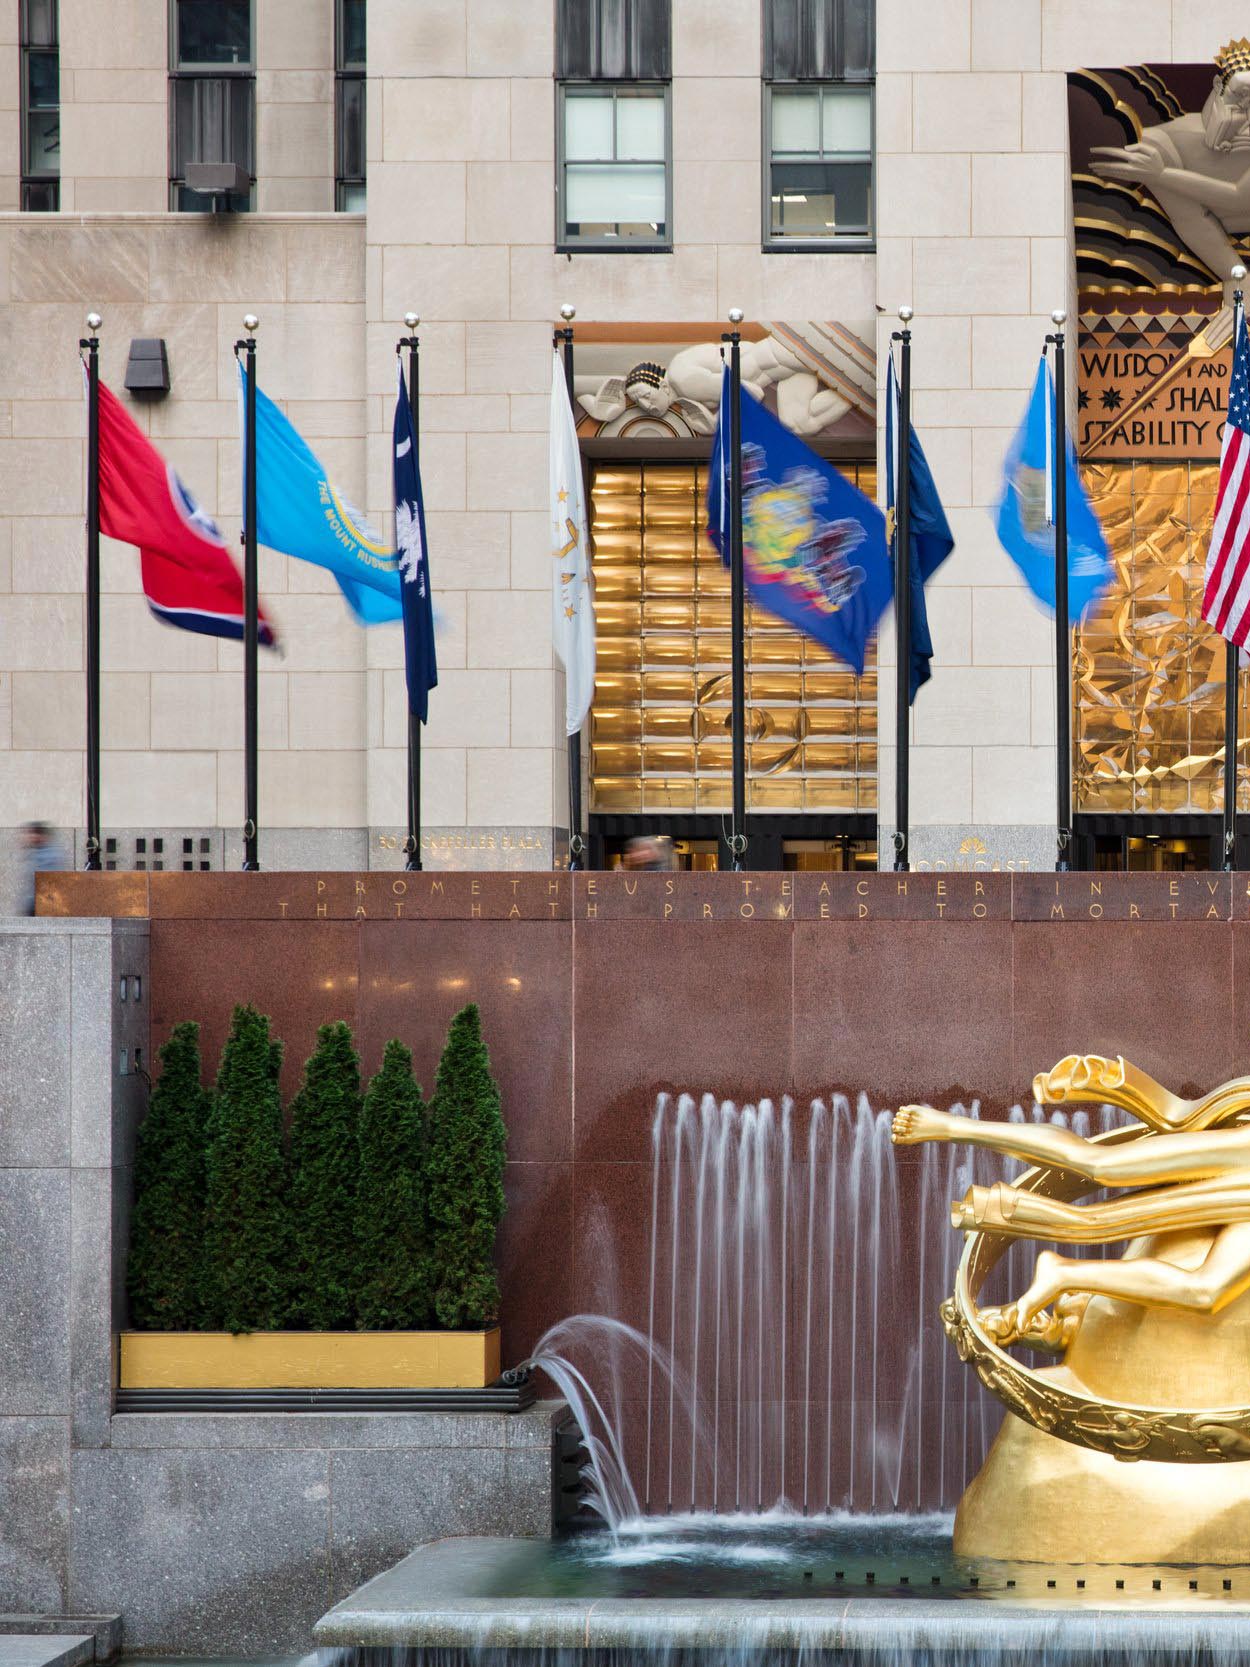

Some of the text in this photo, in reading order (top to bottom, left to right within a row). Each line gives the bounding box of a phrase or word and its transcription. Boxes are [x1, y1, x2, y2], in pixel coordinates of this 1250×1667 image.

[1198, 363, 1228, 378] AND
[1165, 387, 1229, 412] SHAL
[1080, 420, 1211, 446] STABILITY
[317, 480, 331, 505] THE
[324, 508, 357, 552] MOUNT
[501, 836, 543, 849] PLAZA
[317, 880, 675, 895] PROMETHEUS
[741, 880, 986, 895] TEACHER
[1055, 881, 1102, 895] IN
[278, 903, 404, 917] THAT
[471, 903, 598, 918] HATH
[664, 903, 869, 918] PROVED
[935, 903, 987, 918] TO
